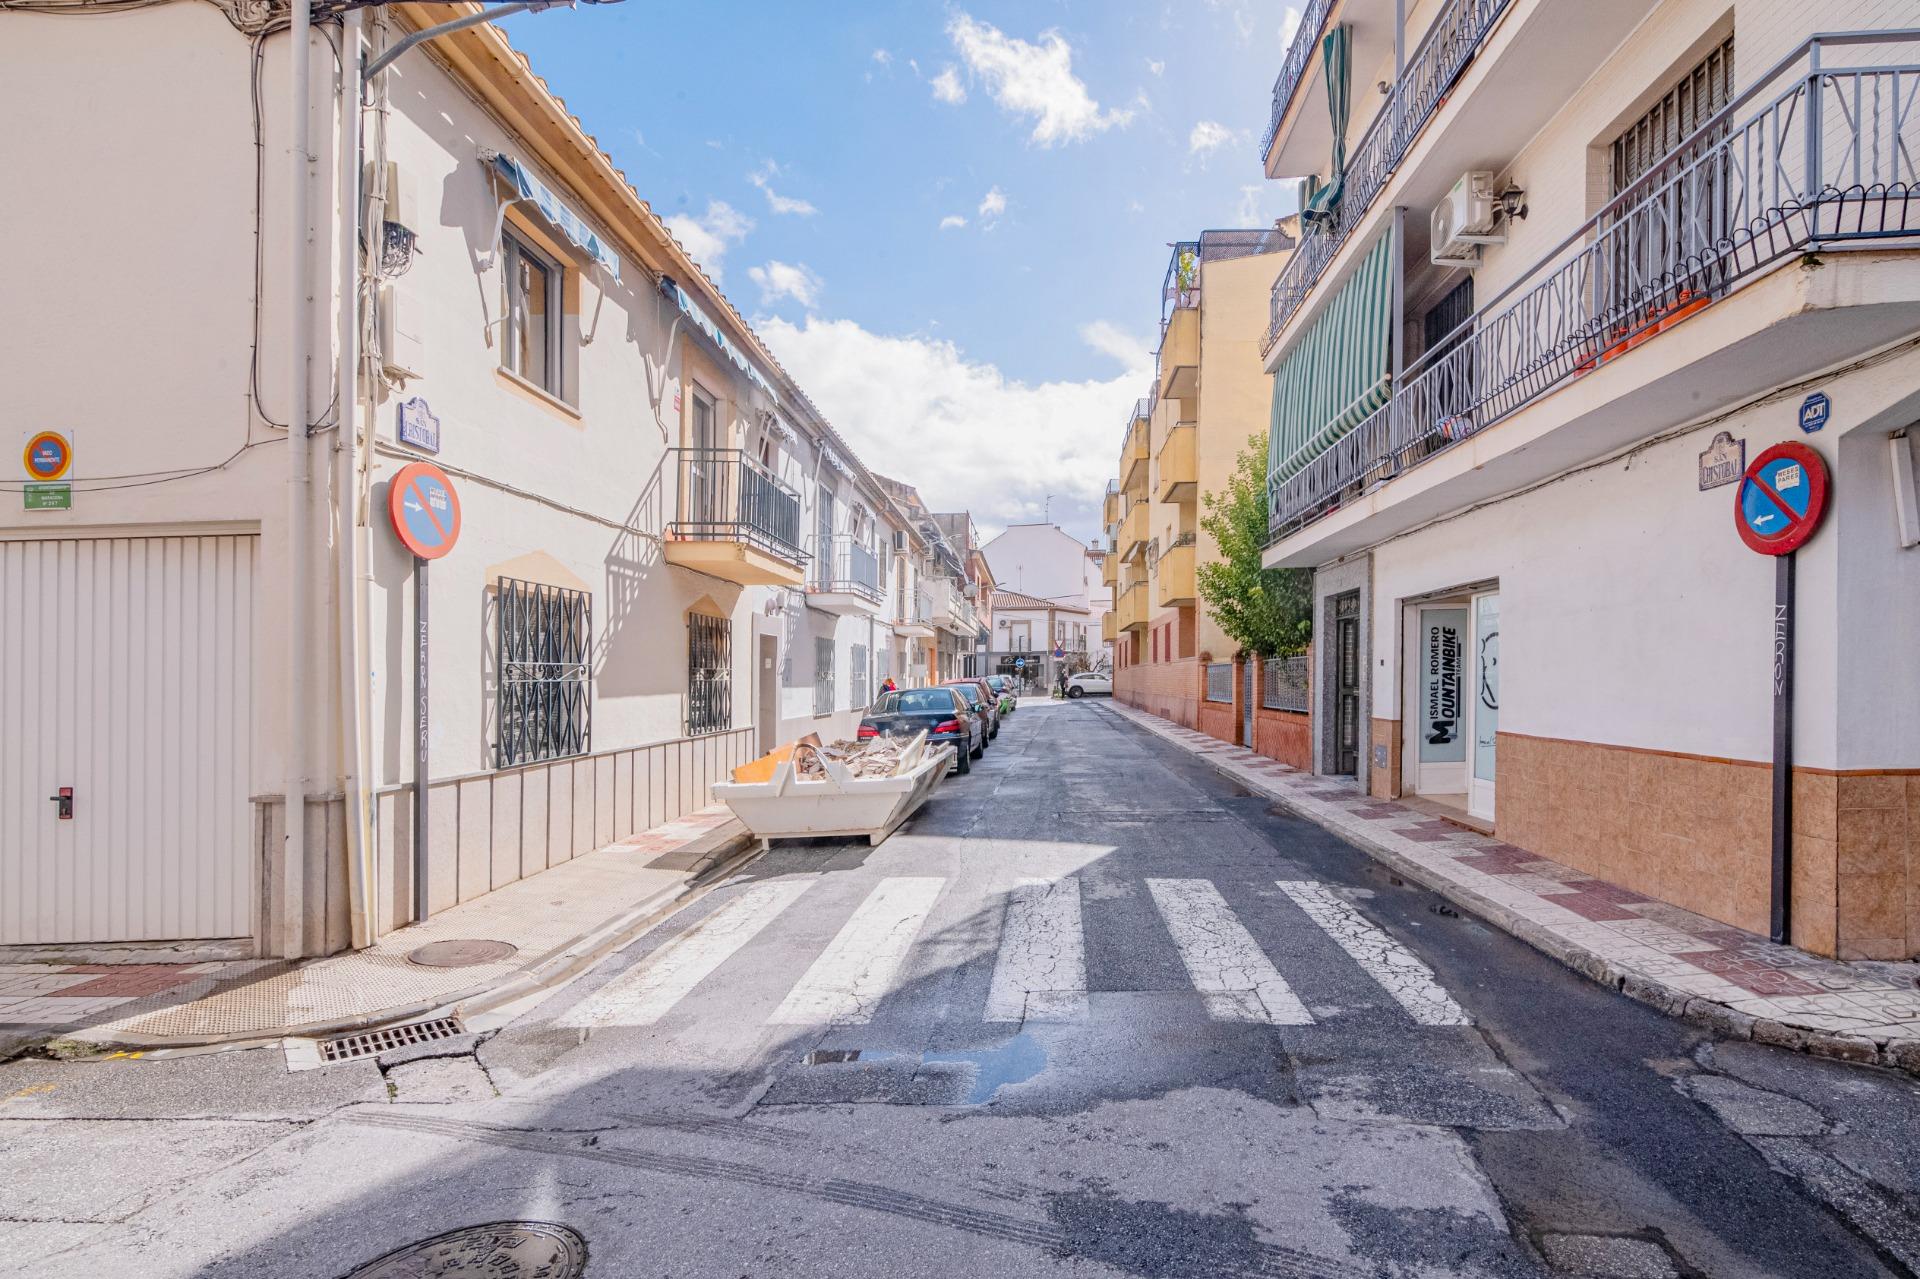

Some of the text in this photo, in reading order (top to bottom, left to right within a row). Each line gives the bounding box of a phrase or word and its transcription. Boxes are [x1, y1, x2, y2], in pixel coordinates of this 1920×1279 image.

[1803, 402, 1825, 422] ADT
[1714, 453, 1727, 463] SAN
[1777, 466, 1799, 477] MESES
[1777, 473, 1799, 483] PARES
[1430, 626, 1440, 720] ISMAEL ROMERO
[1429, 626, 1457, 745] MOUNTAINBIKE
